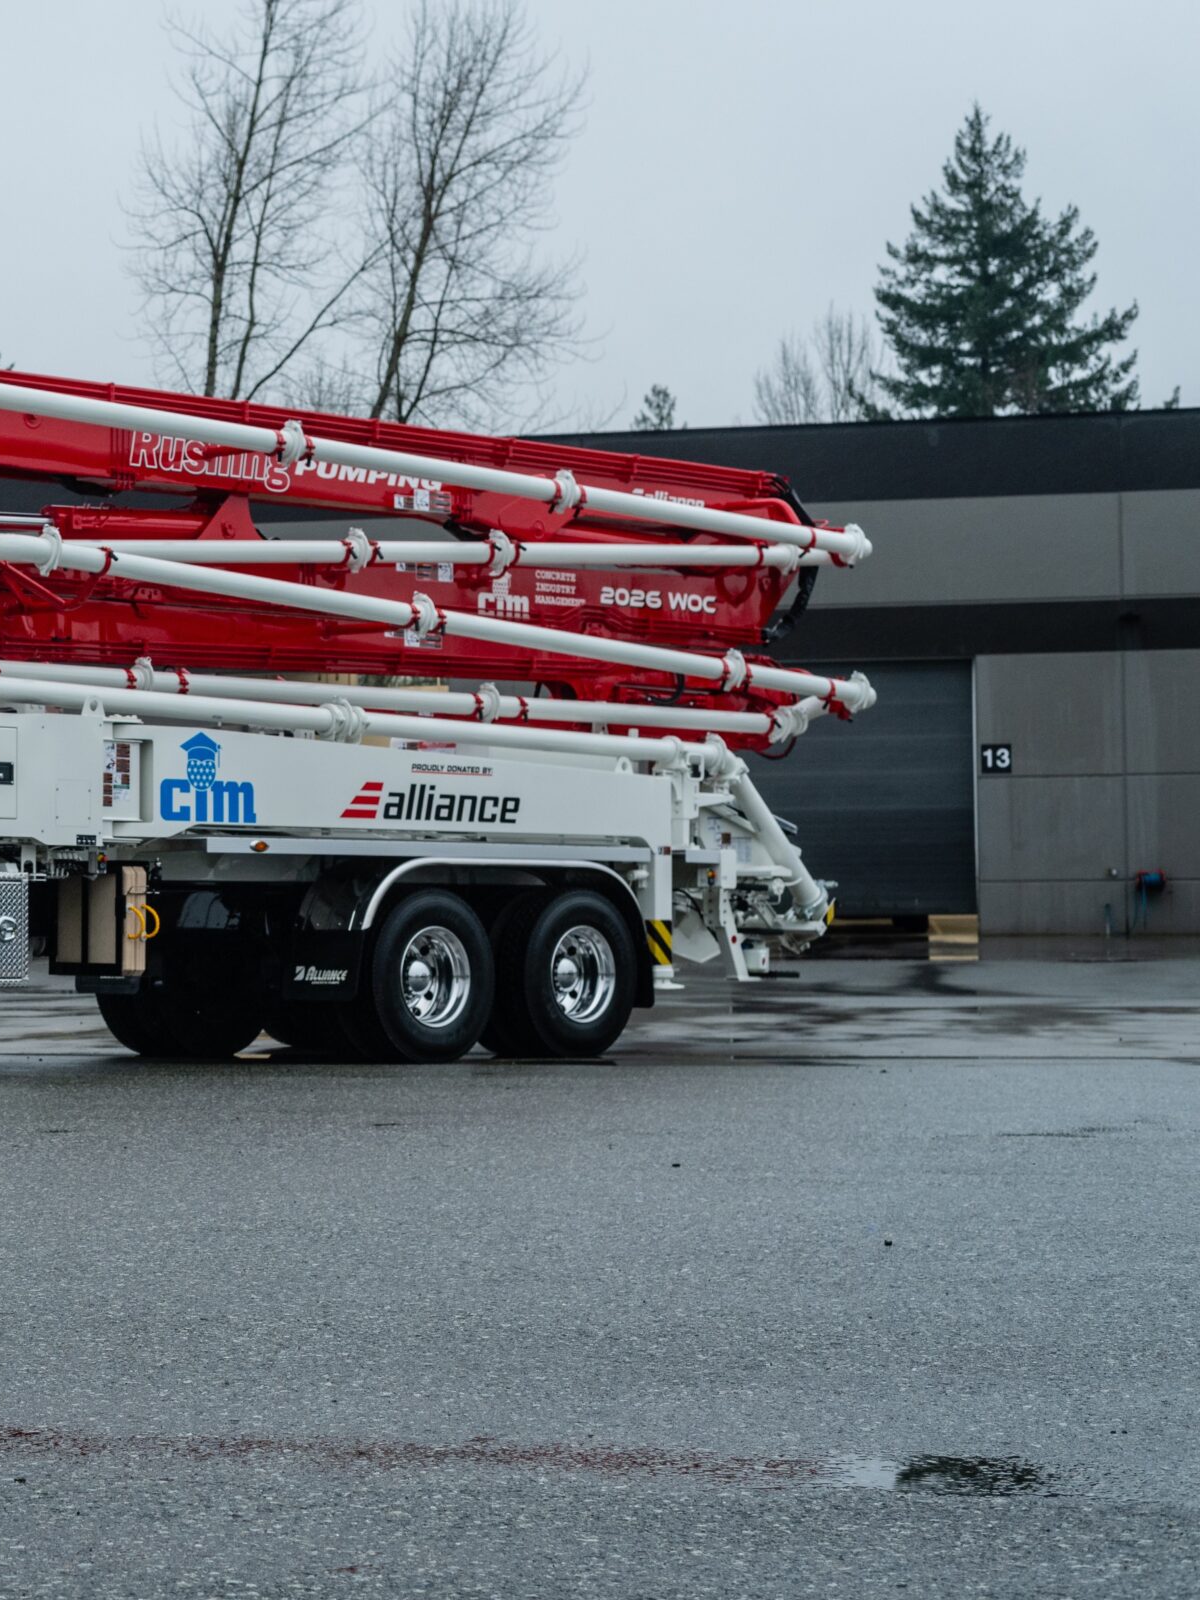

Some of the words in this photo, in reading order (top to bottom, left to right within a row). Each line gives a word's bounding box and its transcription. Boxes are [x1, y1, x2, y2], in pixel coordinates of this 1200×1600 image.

[294, 459, 443, 491] PUMPING
[600, 586, 662, 609] 2026
[667, 591, 717, 614] WOC
[411, 763, 444, 772] PROUDLY
[447, 765, 480, 774] DONATED
[982, 747, 1011, 769] 13
[382, 783, 521, 824] alliance
